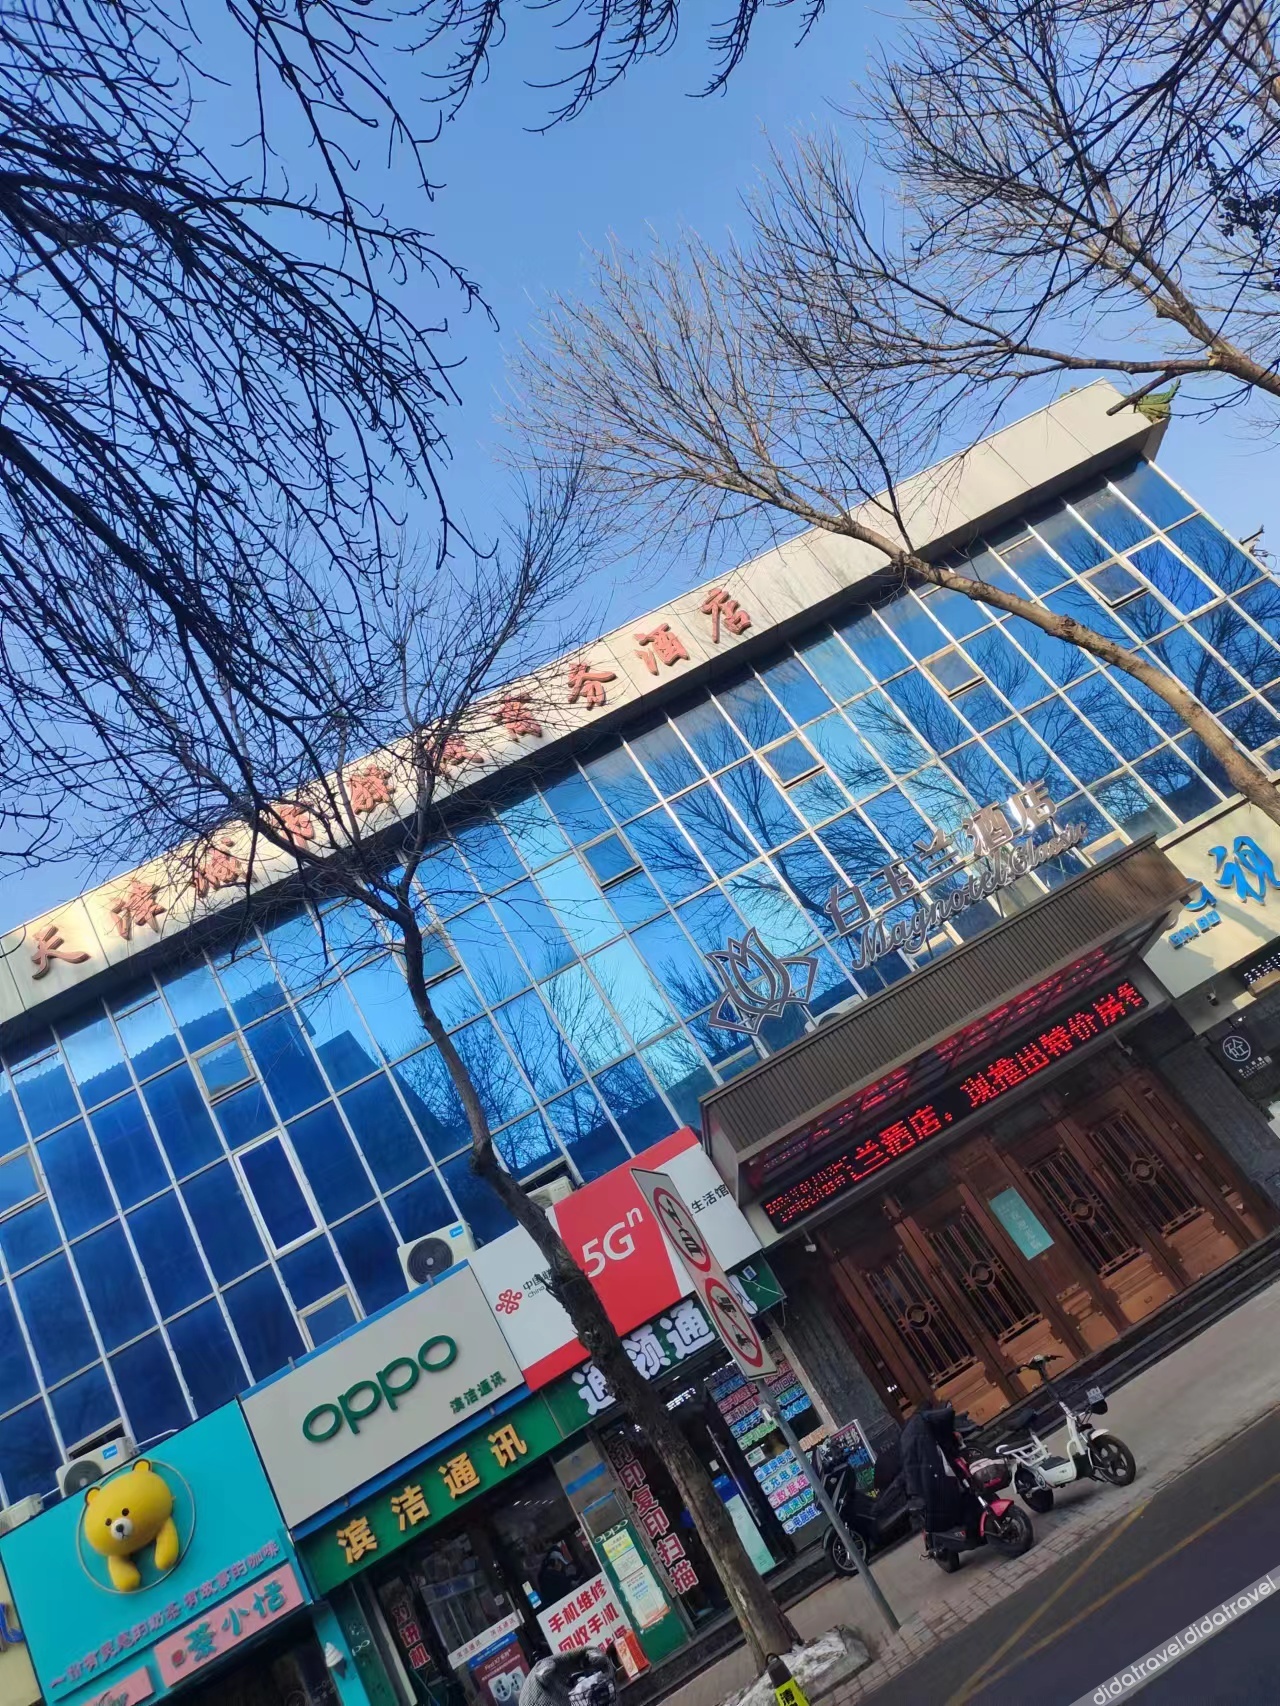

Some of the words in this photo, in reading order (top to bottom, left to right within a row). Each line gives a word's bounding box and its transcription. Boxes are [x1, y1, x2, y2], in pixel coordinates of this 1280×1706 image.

[825, 781, 1057, 935] 白玉兰酒店
[852, 850, 1009, 970] Magnotel
[1007, 821, 1088, 878] Classic
[686, 1184, 730, 1217] 生活馆
[302, 1334, 457, 1443] oppo
[449, 1371, 508, 1414] 滨洁通讯
[336, 1424, 527, 1564] 滨洁通讯
[770, 1461, 801, 1490] 充电器
[775, 1475, 810, 1503] 数据线
[594, 1518, 629, 1544] oppo
[548, 1580, 608, 1634] 手机维修
[558, 1602, 620, 1653] 回收手机
